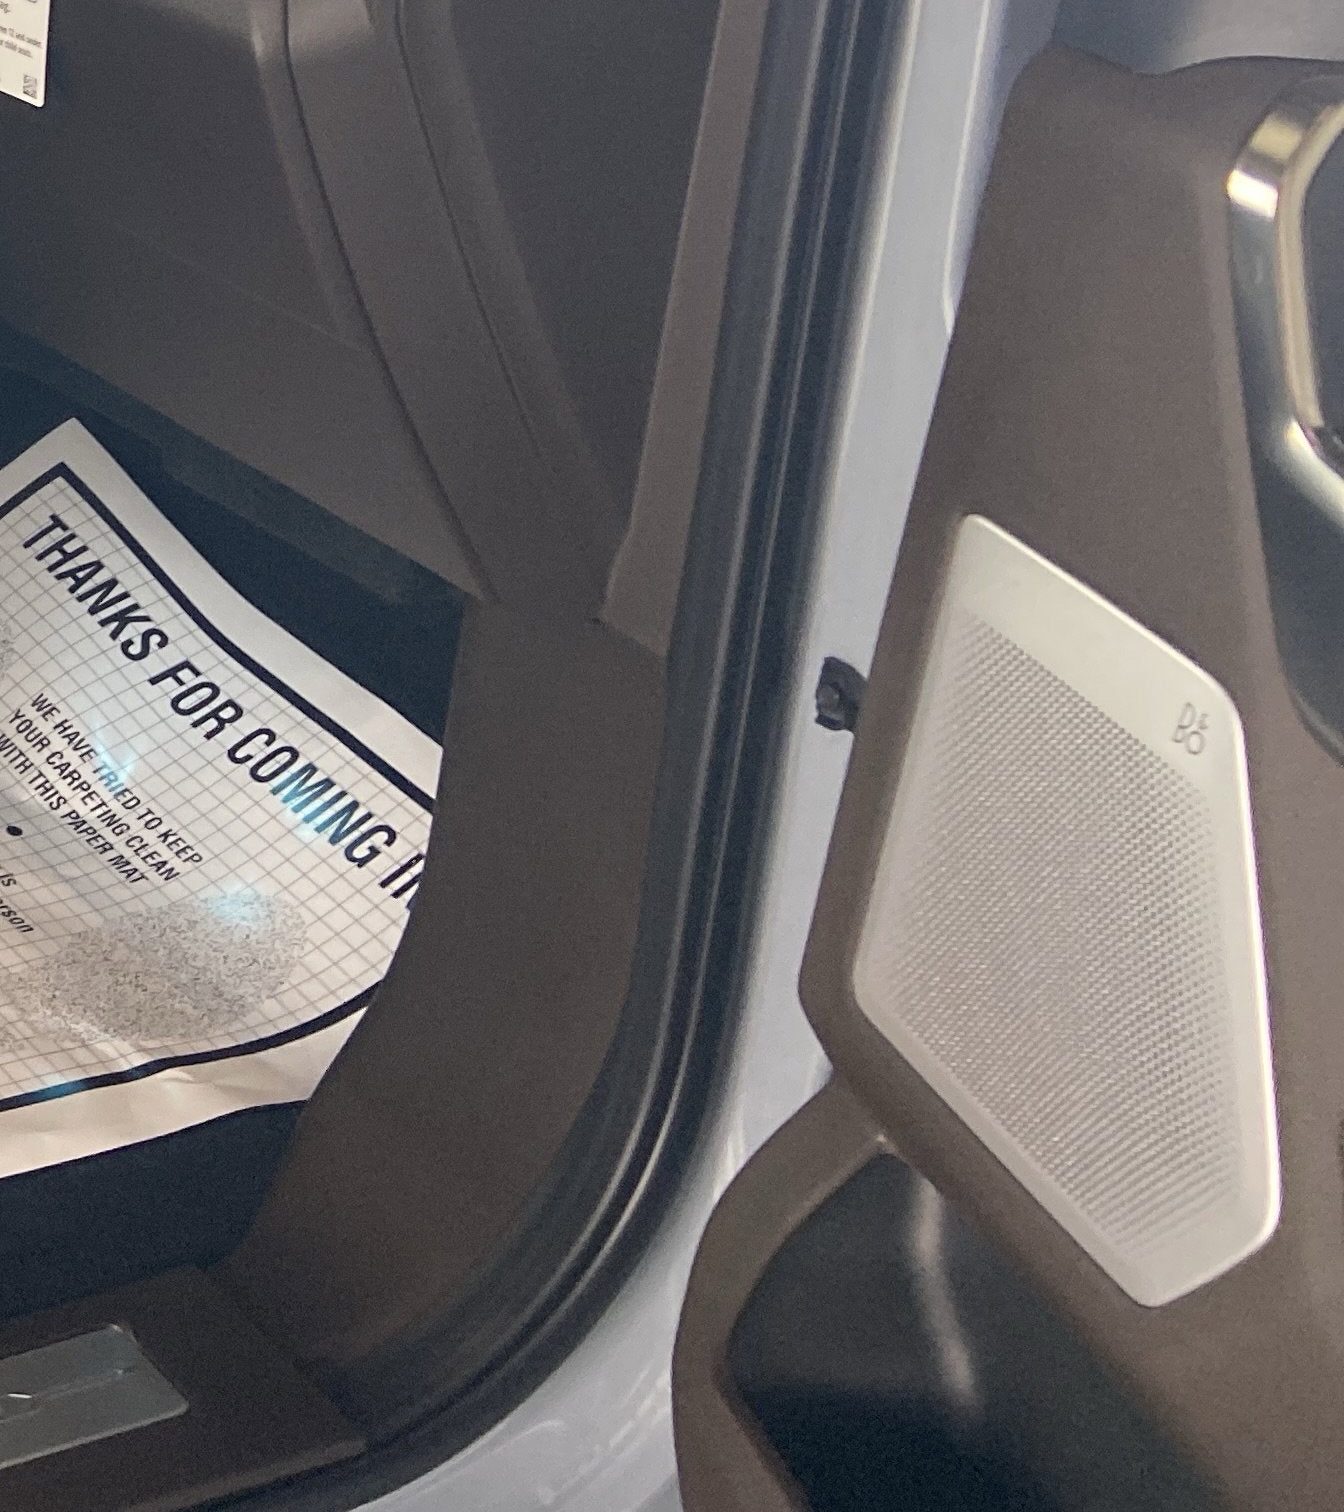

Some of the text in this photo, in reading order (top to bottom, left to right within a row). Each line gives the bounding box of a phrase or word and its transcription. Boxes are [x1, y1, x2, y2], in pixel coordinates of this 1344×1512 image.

[22, 513, 169, 661] THANKS
[147, 659, 244, 741] FOR
[227, 727, 397, 868] COMING
[8, 708, 181, 882] YOUR CARPETING CLEAN
[28, 769, 68, 811] THIS
[60, 809, 115, 855] PAPER
[107, 853, 150, 884] MAT
[30, 693, 203, 866] WE HAVE TRIED TO KEEP
